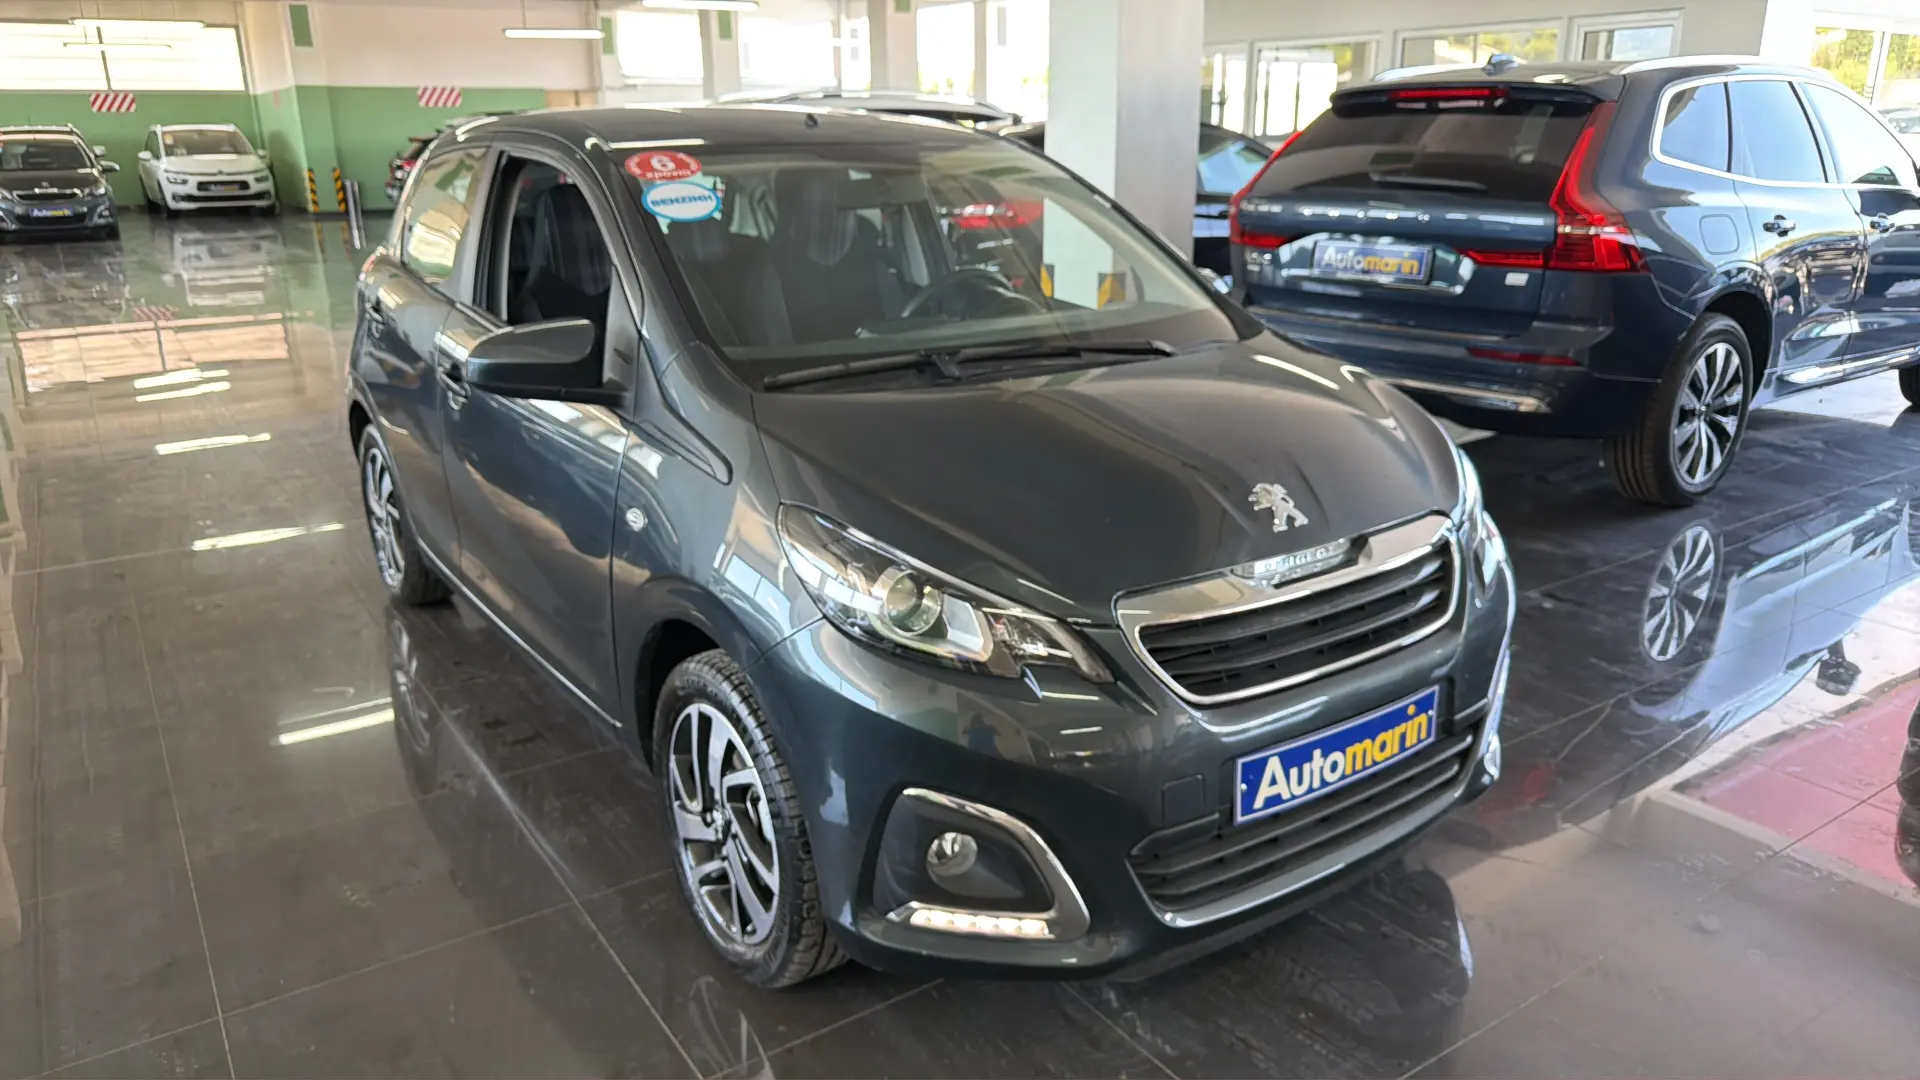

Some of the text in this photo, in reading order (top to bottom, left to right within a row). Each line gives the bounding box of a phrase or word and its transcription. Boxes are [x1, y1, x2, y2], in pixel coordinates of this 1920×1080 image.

[649, 155, 677, 173] 6
[1321, 244, 1420, 275] Automarin
[1252, 704, 1428, 810] Automarin
